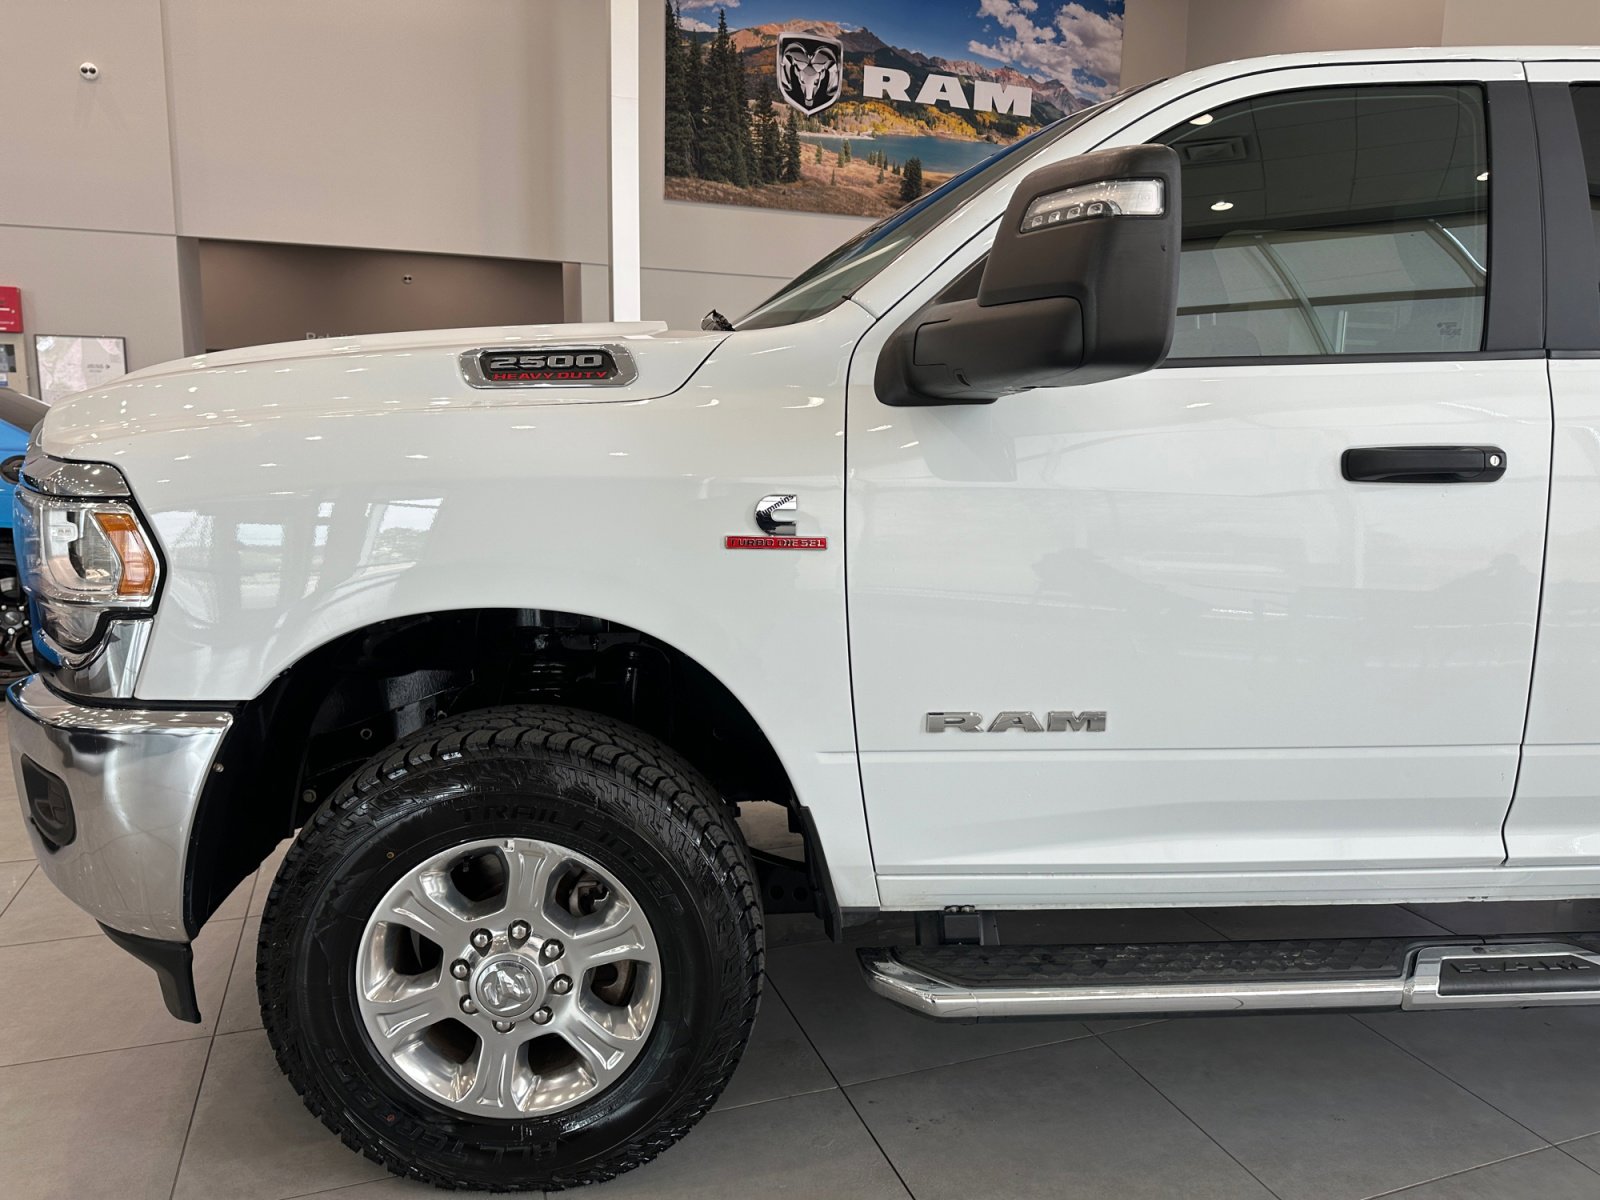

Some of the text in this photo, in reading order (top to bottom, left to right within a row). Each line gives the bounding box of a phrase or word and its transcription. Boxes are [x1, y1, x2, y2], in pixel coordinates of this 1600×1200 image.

[863, 64, 1033, 118] RAM
[489, 353, 603, 369] 2500
[493, 370, 608, 382] HEAVY DUTY
[756, 494, 795, 518] ummins
[729, 538, 826, 548] TURBO DIESEL
[925, 710, 1108, 732] RAM
